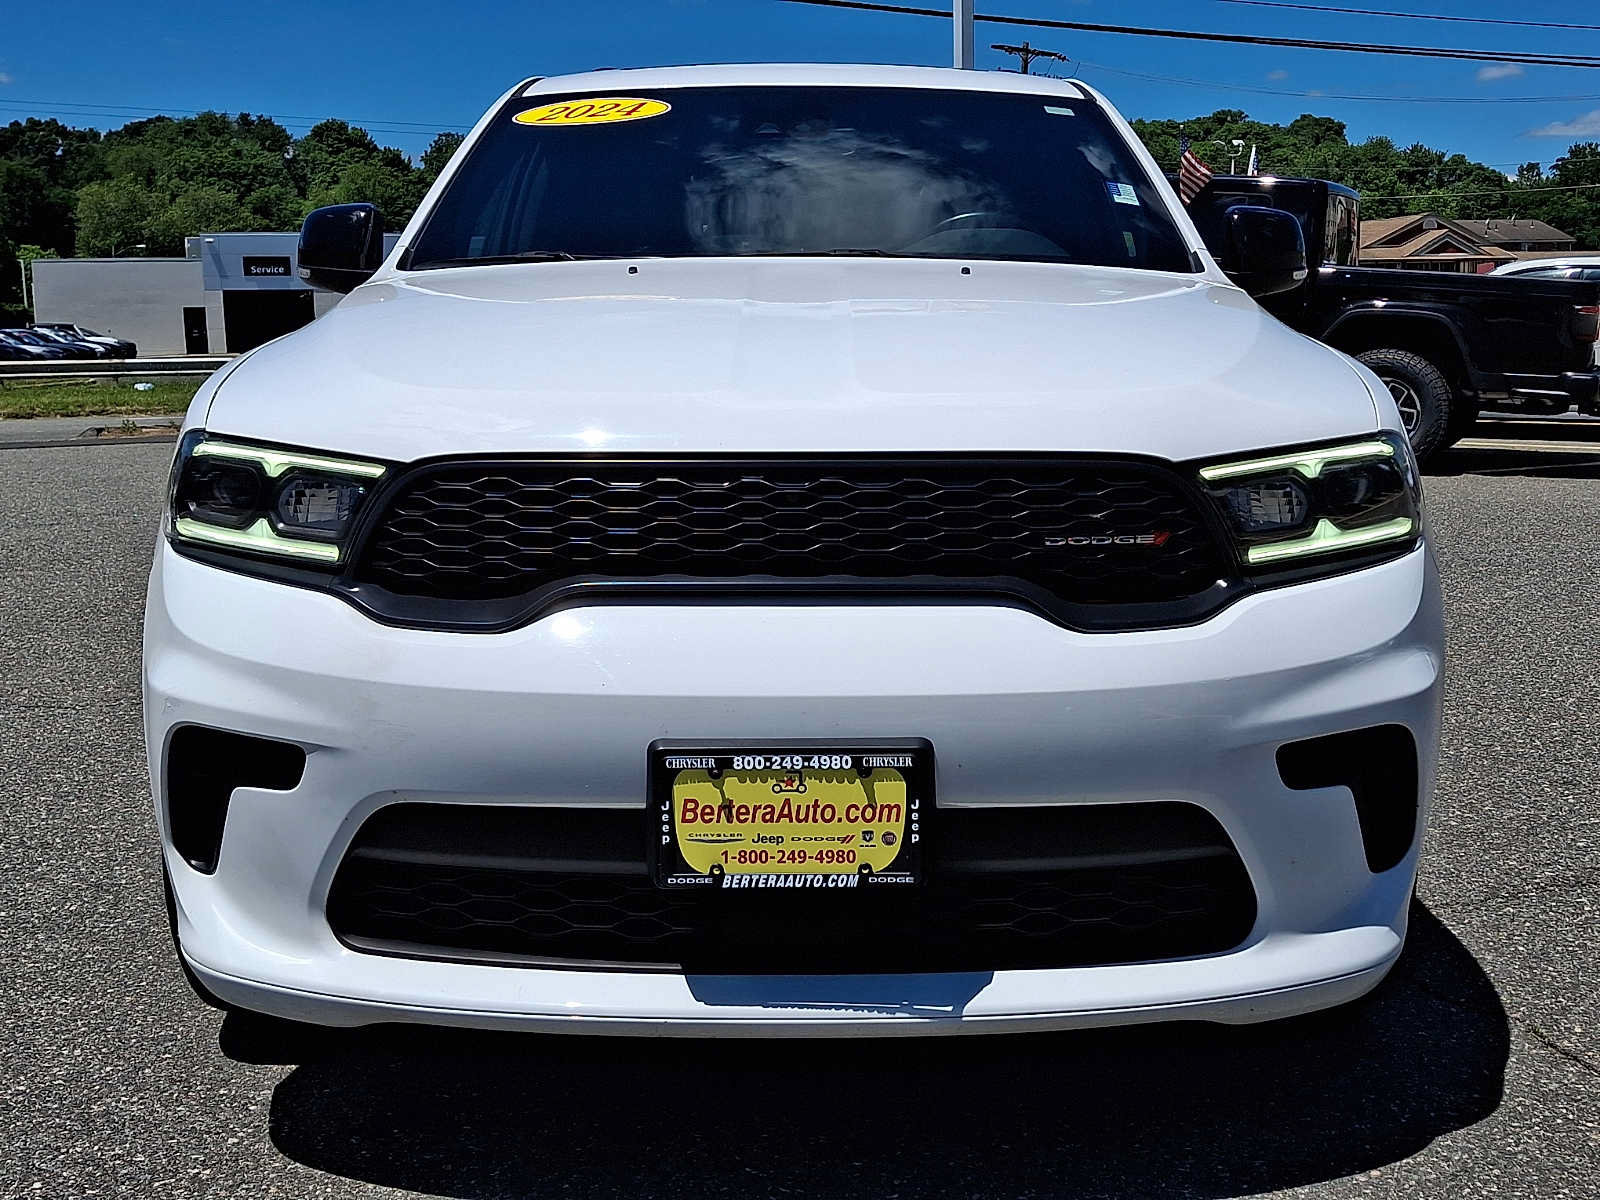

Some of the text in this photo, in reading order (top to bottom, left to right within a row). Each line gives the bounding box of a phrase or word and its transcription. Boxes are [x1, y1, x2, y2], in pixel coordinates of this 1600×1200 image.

[536, 102, 648, 121] 2024
[250, 265, 285, 274] Service
[1044, 534, 1156, 546] DODGE
[665, 756, 913, 770] CHRYSLER 800-249-4980 CHRYSLER
[680, 797, 902, 824] BerteraAuto.com
[660, 800, 671, 845] Jeep
[910, 799, 920, 844] Jeep
[751, 832, 785, 846] Jeep
[720, 849, 857, 864] 1-800-249-4980
[667, 874, 915, 889] DODGE BERTERAAUTO.COM DODGE
